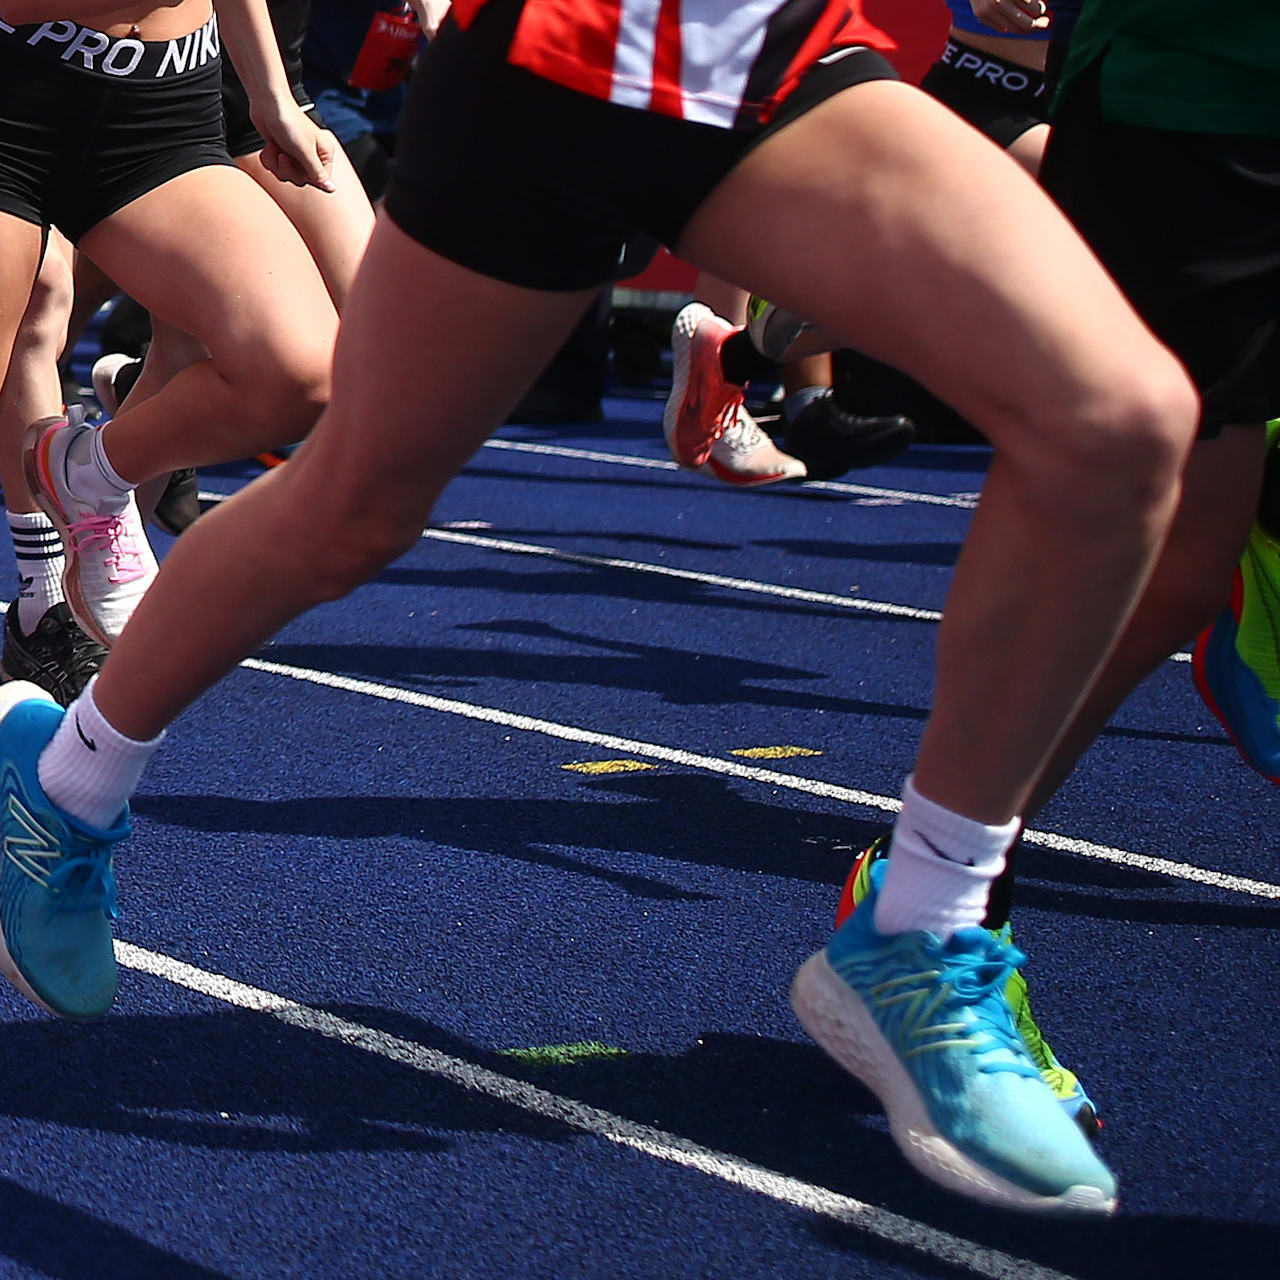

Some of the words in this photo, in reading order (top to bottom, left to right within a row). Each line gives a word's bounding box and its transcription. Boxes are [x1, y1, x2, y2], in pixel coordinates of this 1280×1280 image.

[26, 20, 146, 77] PRO
[154, 9, 222, 79] NIK
[954, 52, 1030, 92] PRO
